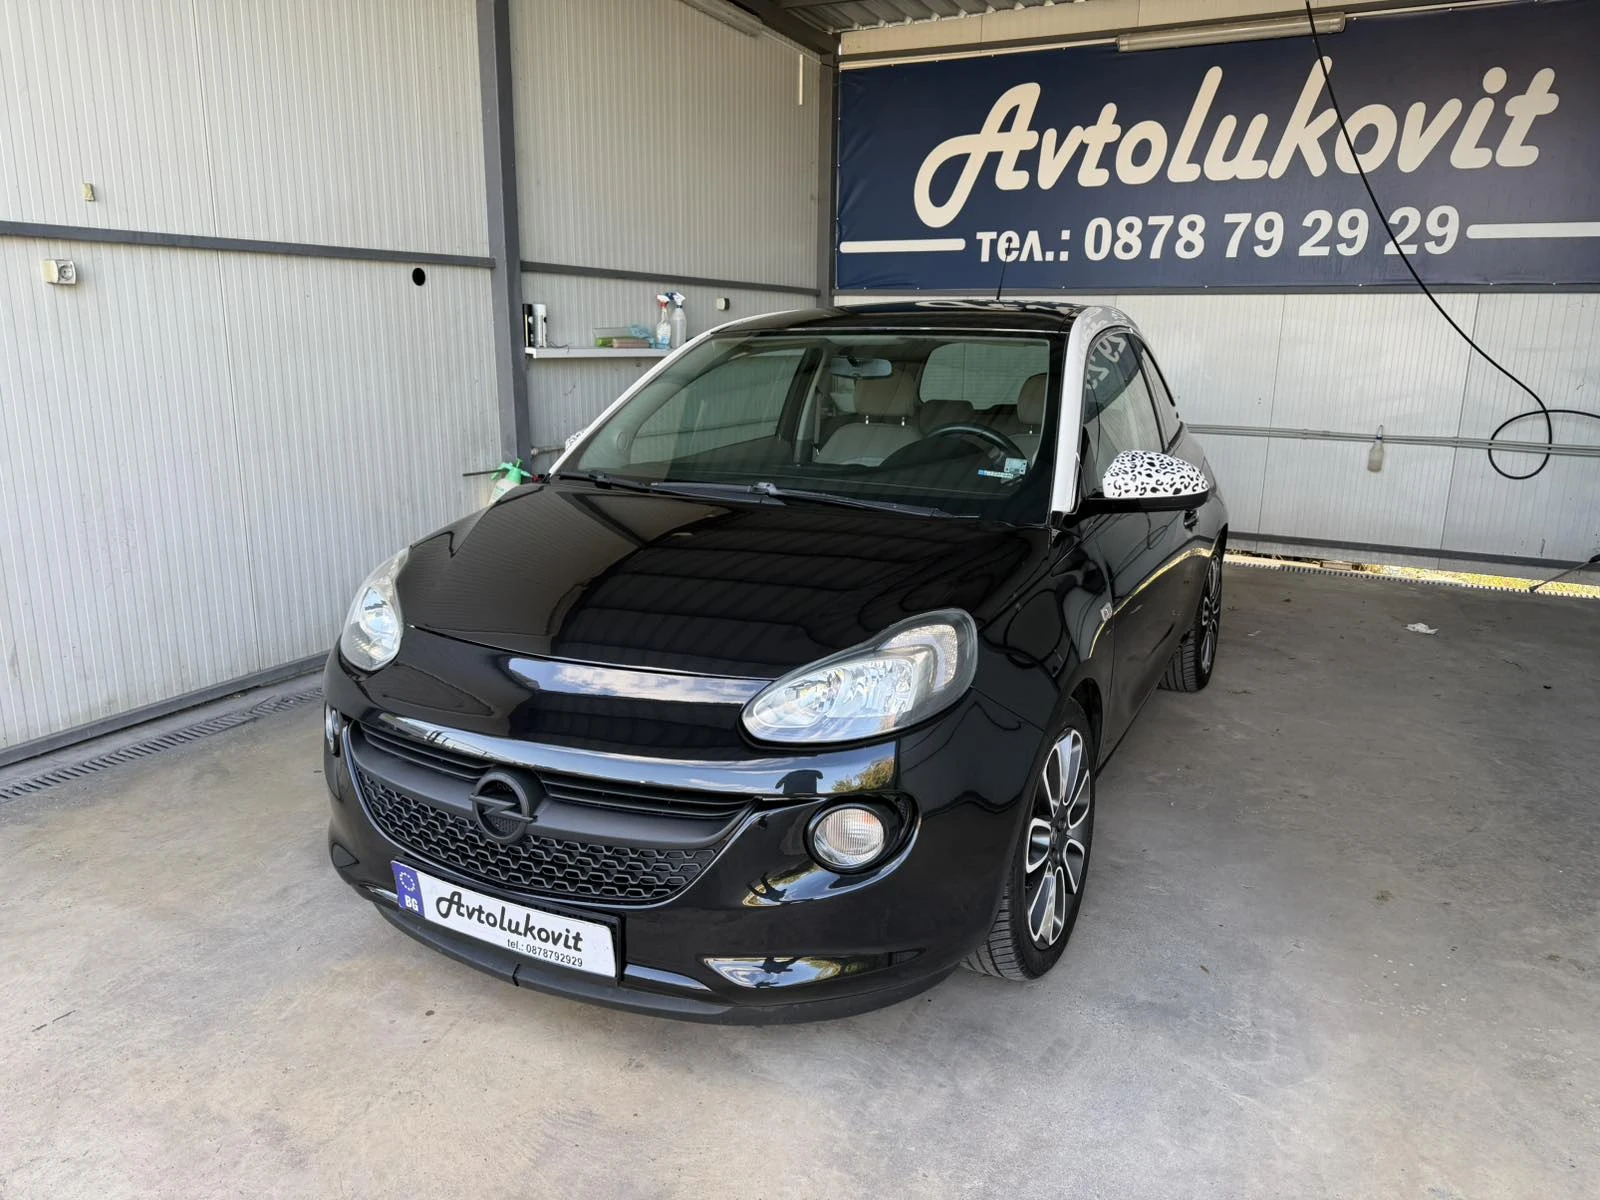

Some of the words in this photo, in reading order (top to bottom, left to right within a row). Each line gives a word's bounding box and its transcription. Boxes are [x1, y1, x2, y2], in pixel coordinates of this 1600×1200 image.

[914, 56, 1560, 229] Avtolukovit
[1084, 214, 1206, 261] 0878
[1223, 211, 1285, 259] 79
[1297, 208, 1370, 257] 29
[1383, 204, 1460, 255] 29
[404, 894, 419, 912] BG
[436, 890, 583, 952] Avtolukovit
[526, 944, 583, 967] 0878792929
